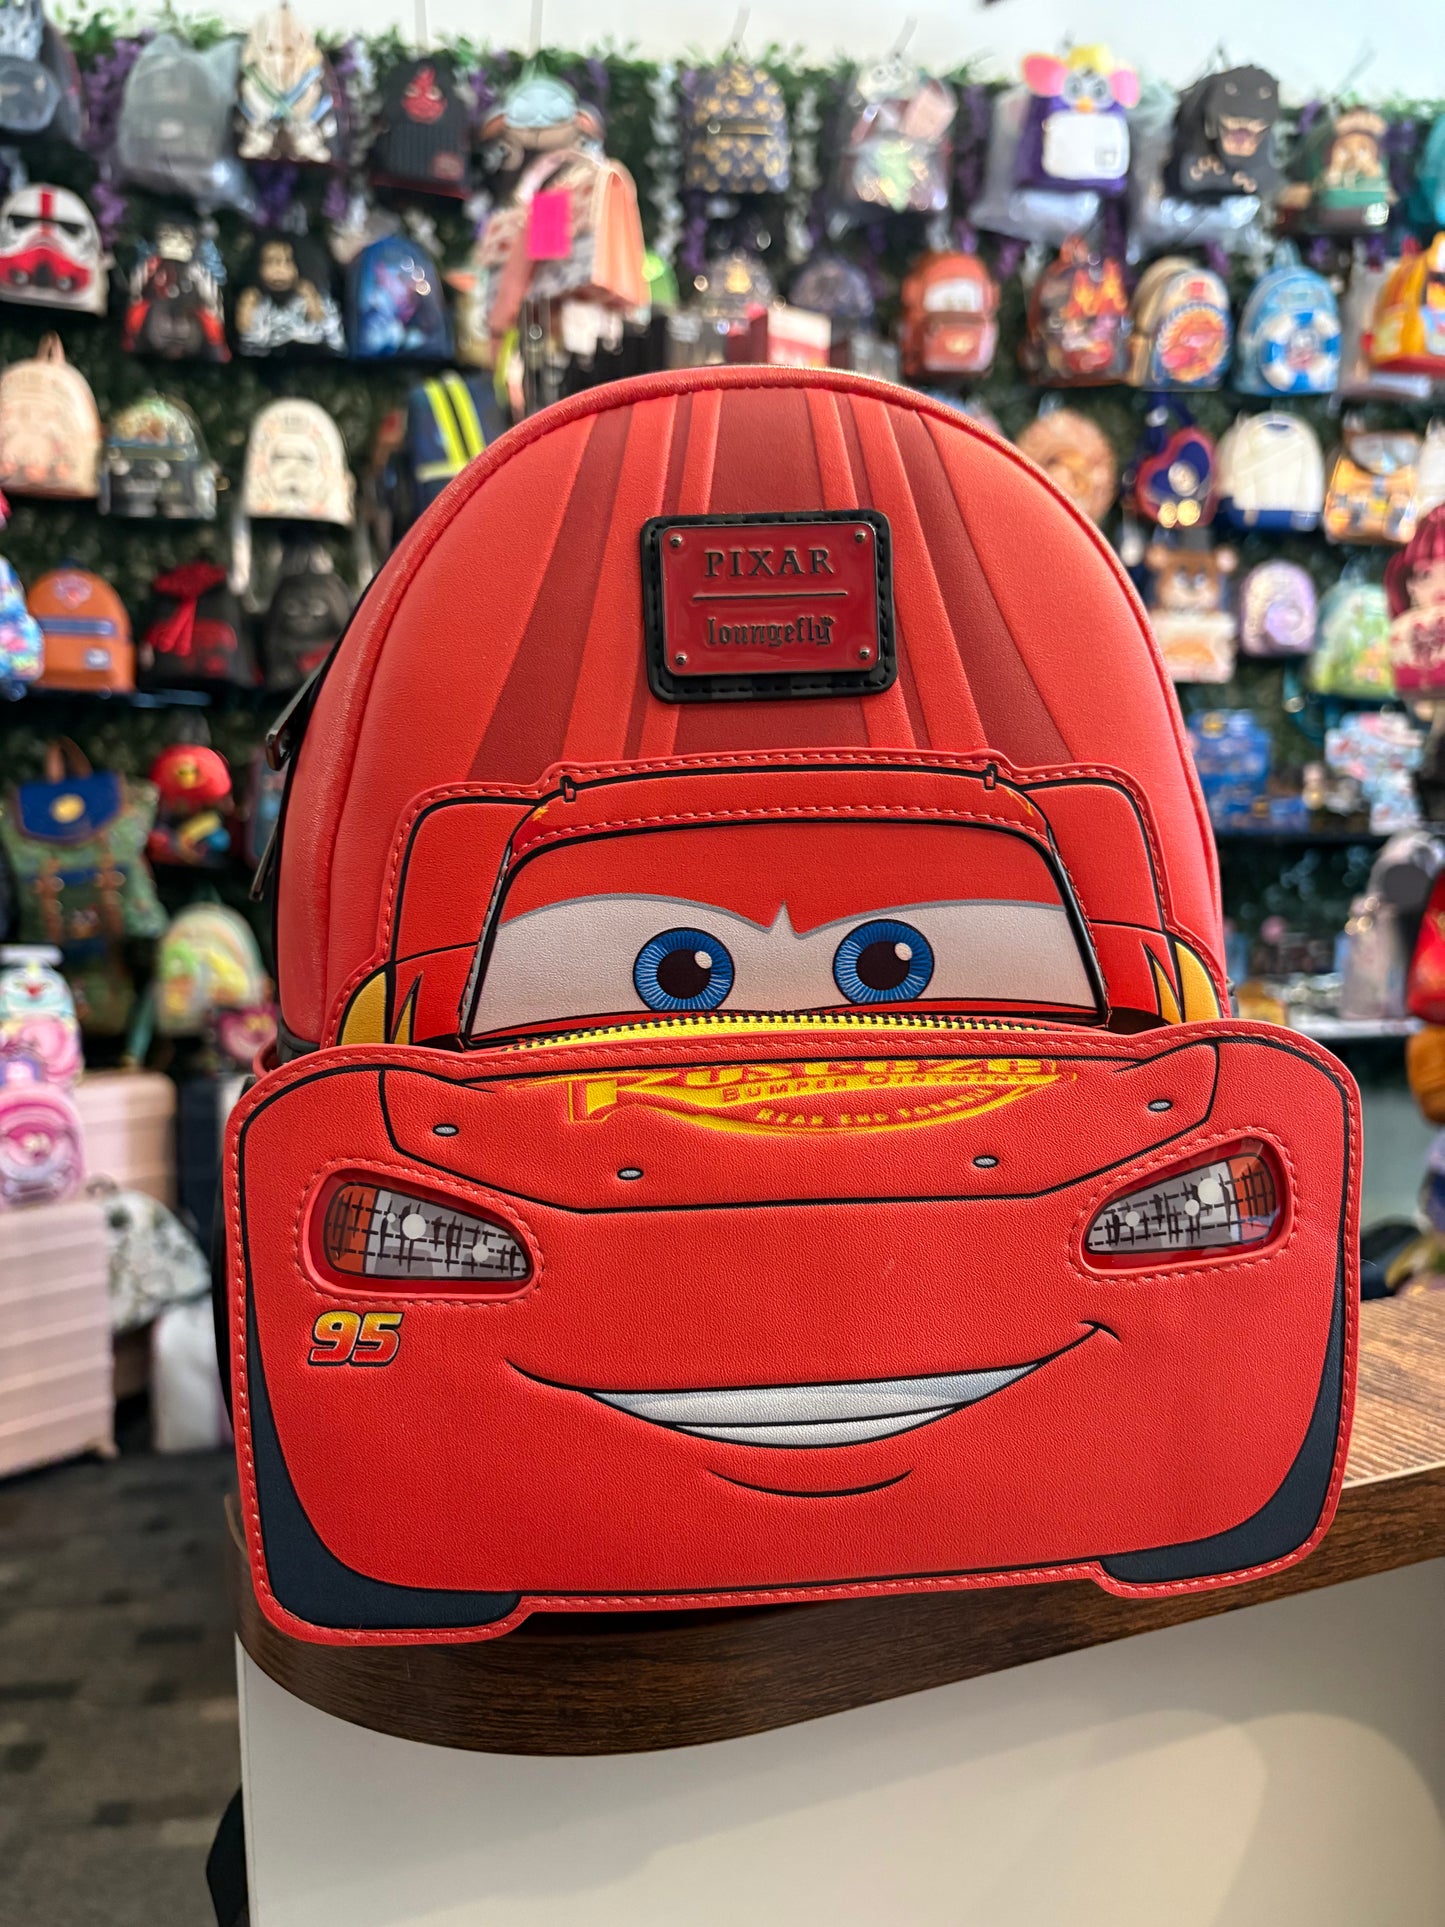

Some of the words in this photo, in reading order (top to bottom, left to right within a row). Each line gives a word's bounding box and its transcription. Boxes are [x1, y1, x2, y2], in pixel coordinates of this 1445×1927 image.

[704, 548, 834, 577] PIXAR
[707, 616, 834, 647] loungefly
[721, 1078, 848, 1103] BUMPER
[868, 1073, 1027, 1086] OINTMENT
[307, 1309, 404, 1368] 95
